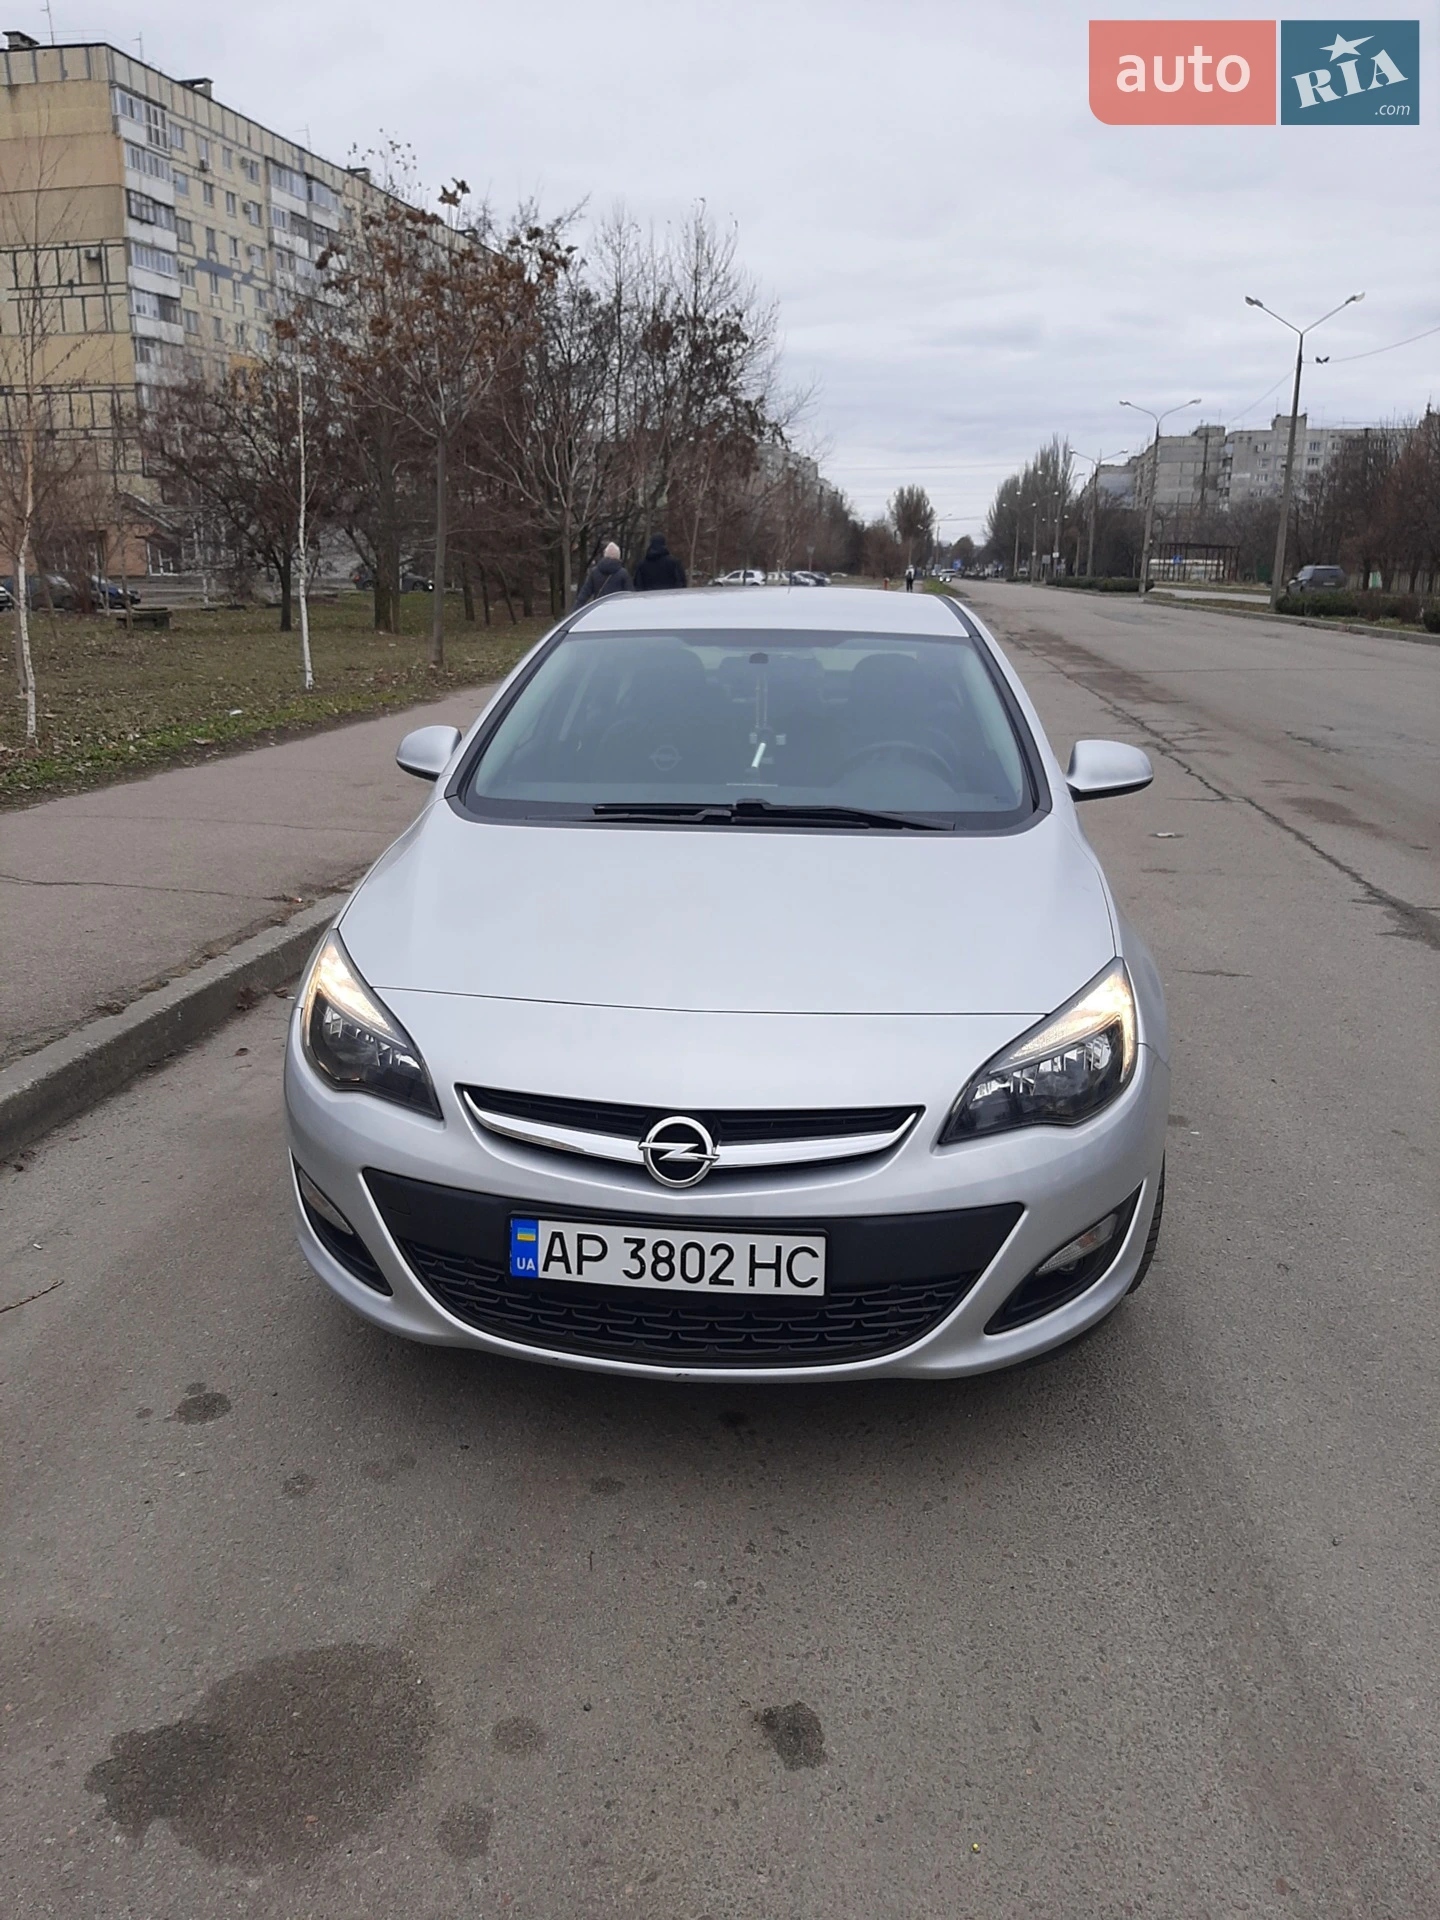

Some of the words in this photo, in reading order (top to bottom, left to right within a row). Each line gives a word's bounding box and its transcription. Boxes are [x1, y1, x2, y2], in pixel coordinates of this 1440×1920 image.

[516, 1258, 536, 1271] UA
[542, 1231, 608, 1275] AP
[622, 1237, 734, 1286] 3802
[748, 1244, 820, 1288] HC
